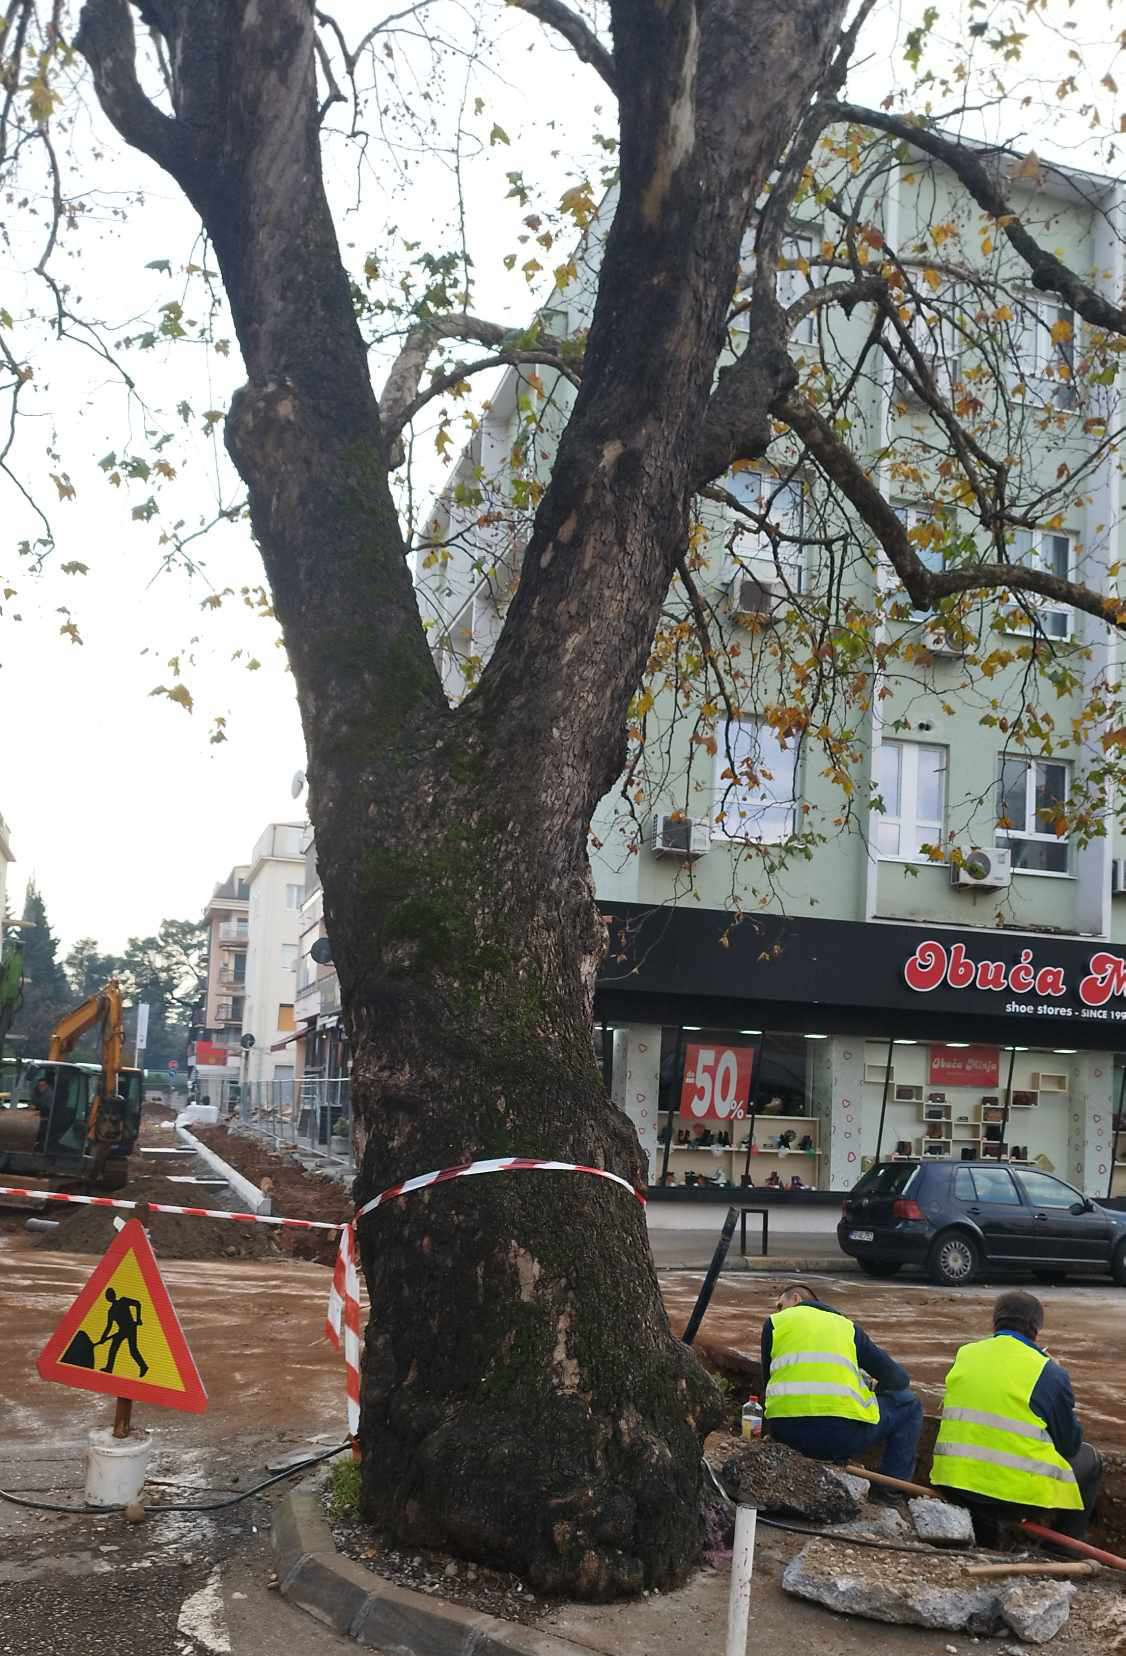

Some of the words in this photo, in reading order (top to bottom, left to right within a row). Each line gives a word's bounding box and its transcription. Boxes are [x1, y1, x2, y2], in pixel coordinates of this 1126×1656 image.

[904, 940, 1067, 997] Obuća
[1005, 1001, 1034, 1013] shoe
[1037, 1004, 1073, 1016] stores
[1080, 1008, 1108, 1019] SINCE
